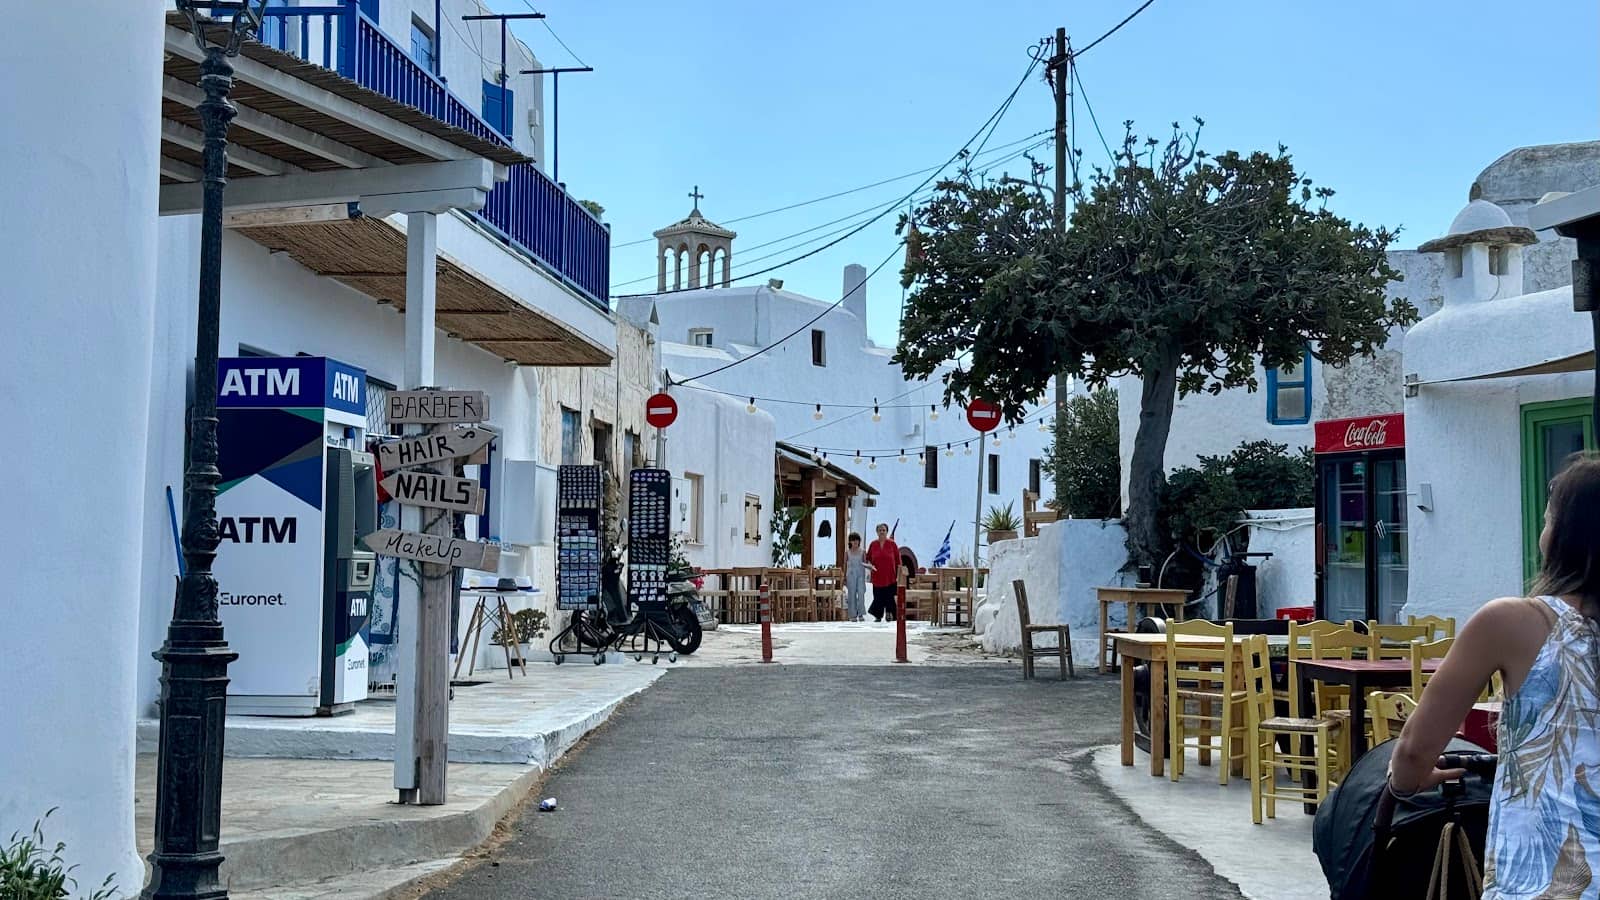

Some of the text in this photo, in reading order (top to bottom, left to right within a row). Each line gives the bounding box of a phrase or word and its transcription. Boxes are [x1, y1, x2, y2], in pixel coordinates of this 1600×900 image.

[220, 368, 300, 396] ATM
[332, 371, 359, 404] ATM
[391, 395, 477, 419] BARBER
[399, 435, 455, 464] HAIR
[395, 474, 471, 504] NAILS
[218, 517, 297, 544] ATM
[350, 598, 367, 616] ATM
